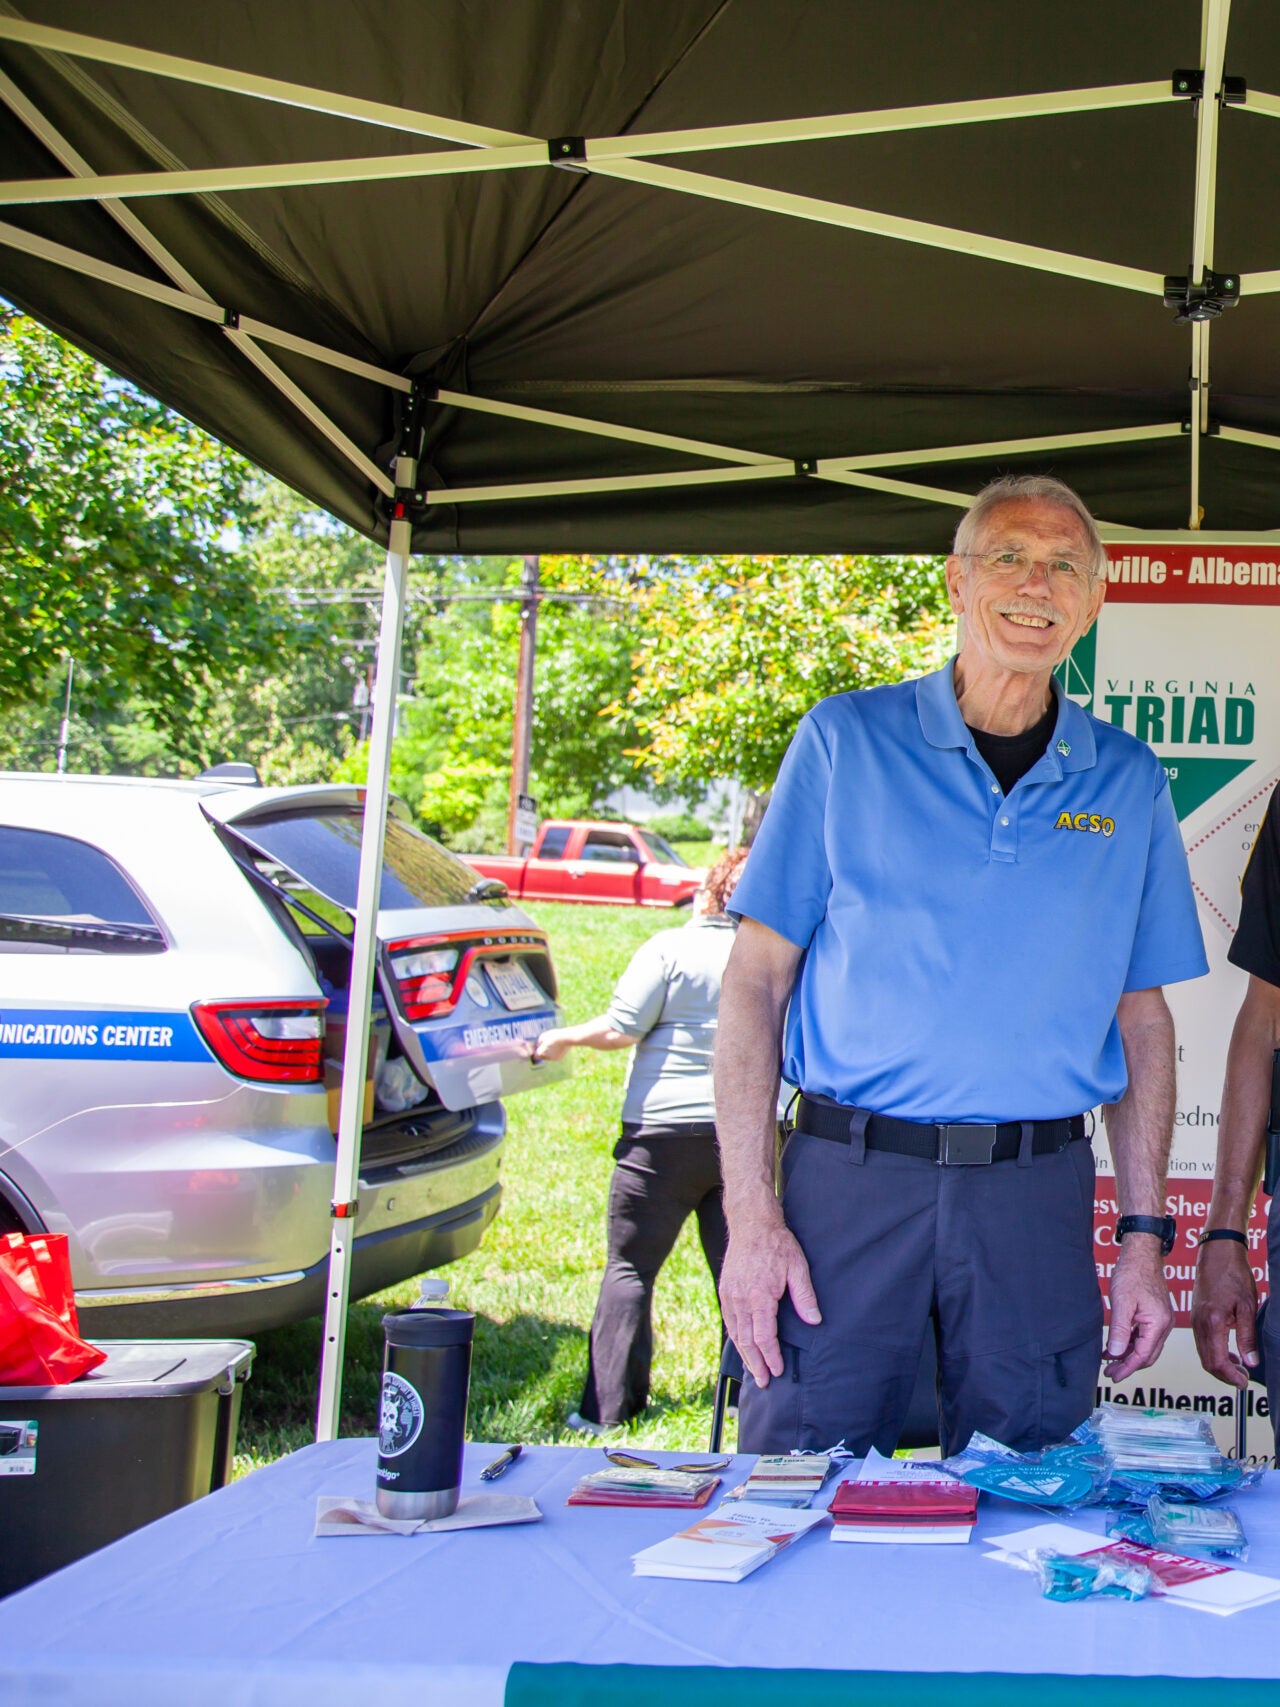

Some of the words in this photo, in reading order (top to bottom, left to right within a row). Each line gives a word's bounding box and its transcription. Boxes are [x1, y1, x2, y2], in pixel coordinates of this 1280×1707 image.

[1106, 556, 1167, 584] ville
[1107, 679, 1257, 697] VIRGINIA
[1104, 695, 1256, 746] TRIAD
[1053, 811, 1116, 838] ACSO
[0, 1023, 99, 1046] NICATIONS
[102, 1025, 173, 1047] CENTER
[1111, 1542, 1157, 1556] FILE
[1151, 1552, 1186, 1563] OF
[1181, 1559, 1228, 1574] LIFE
